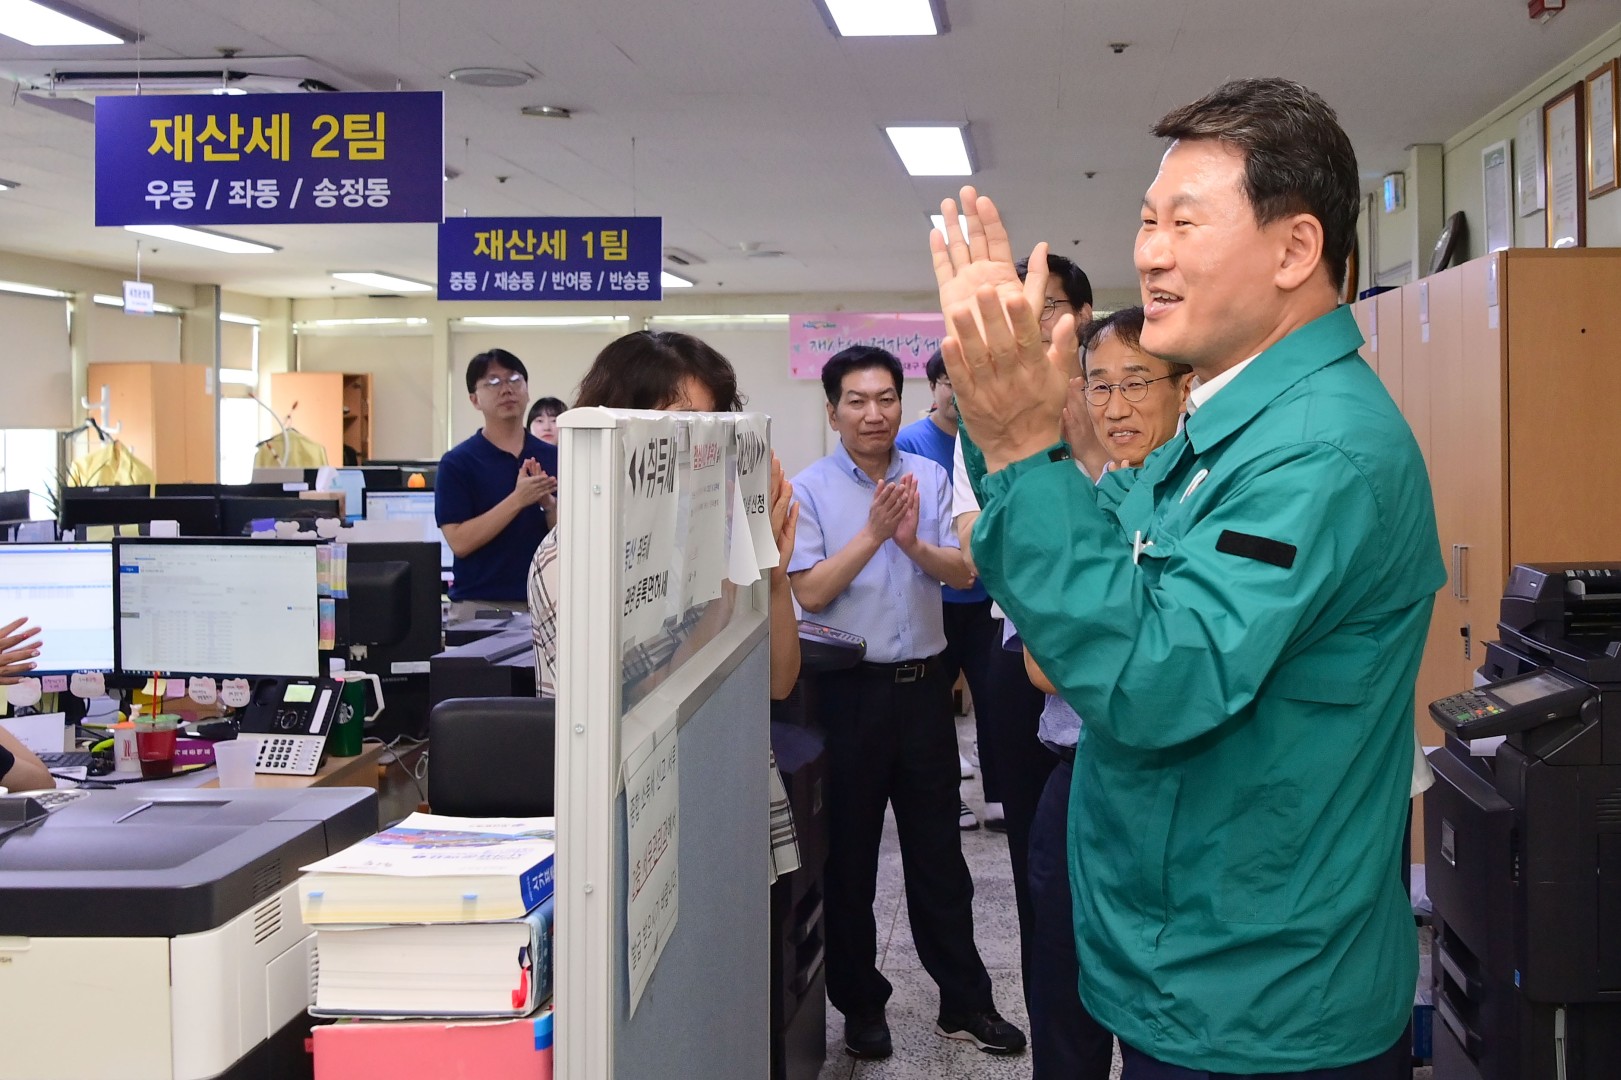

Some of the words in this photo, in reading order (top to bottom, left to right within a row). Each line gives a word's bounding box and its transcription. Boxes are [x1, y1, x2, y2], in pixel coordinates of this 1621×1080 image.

[148, 112, 290, 162] 재산세
[311, 112, 386, 160] 2팀
[145, 180, 196, 209] 우동
[205, 178, 219, 210] /
[228, 178, 280, 209] 좌동
[289, 178, 303, 209] /
[313, 178, 391, 208] 송정동
[473, 229, 567, 261] 재산세
[582, 229, 628, 261] 1팀
[449, 271, 477, 291] 중동
[481, 271, 489, 291] /
[494, 271, 535, 291] 재송동
[539, 271, 547, 291] /
[552, 271, 592, 291] 반여동
[597, 271, 605, 291] /
[609, 271, 650, 291] 반송동
[647, 436, 677, 499] 취득세
